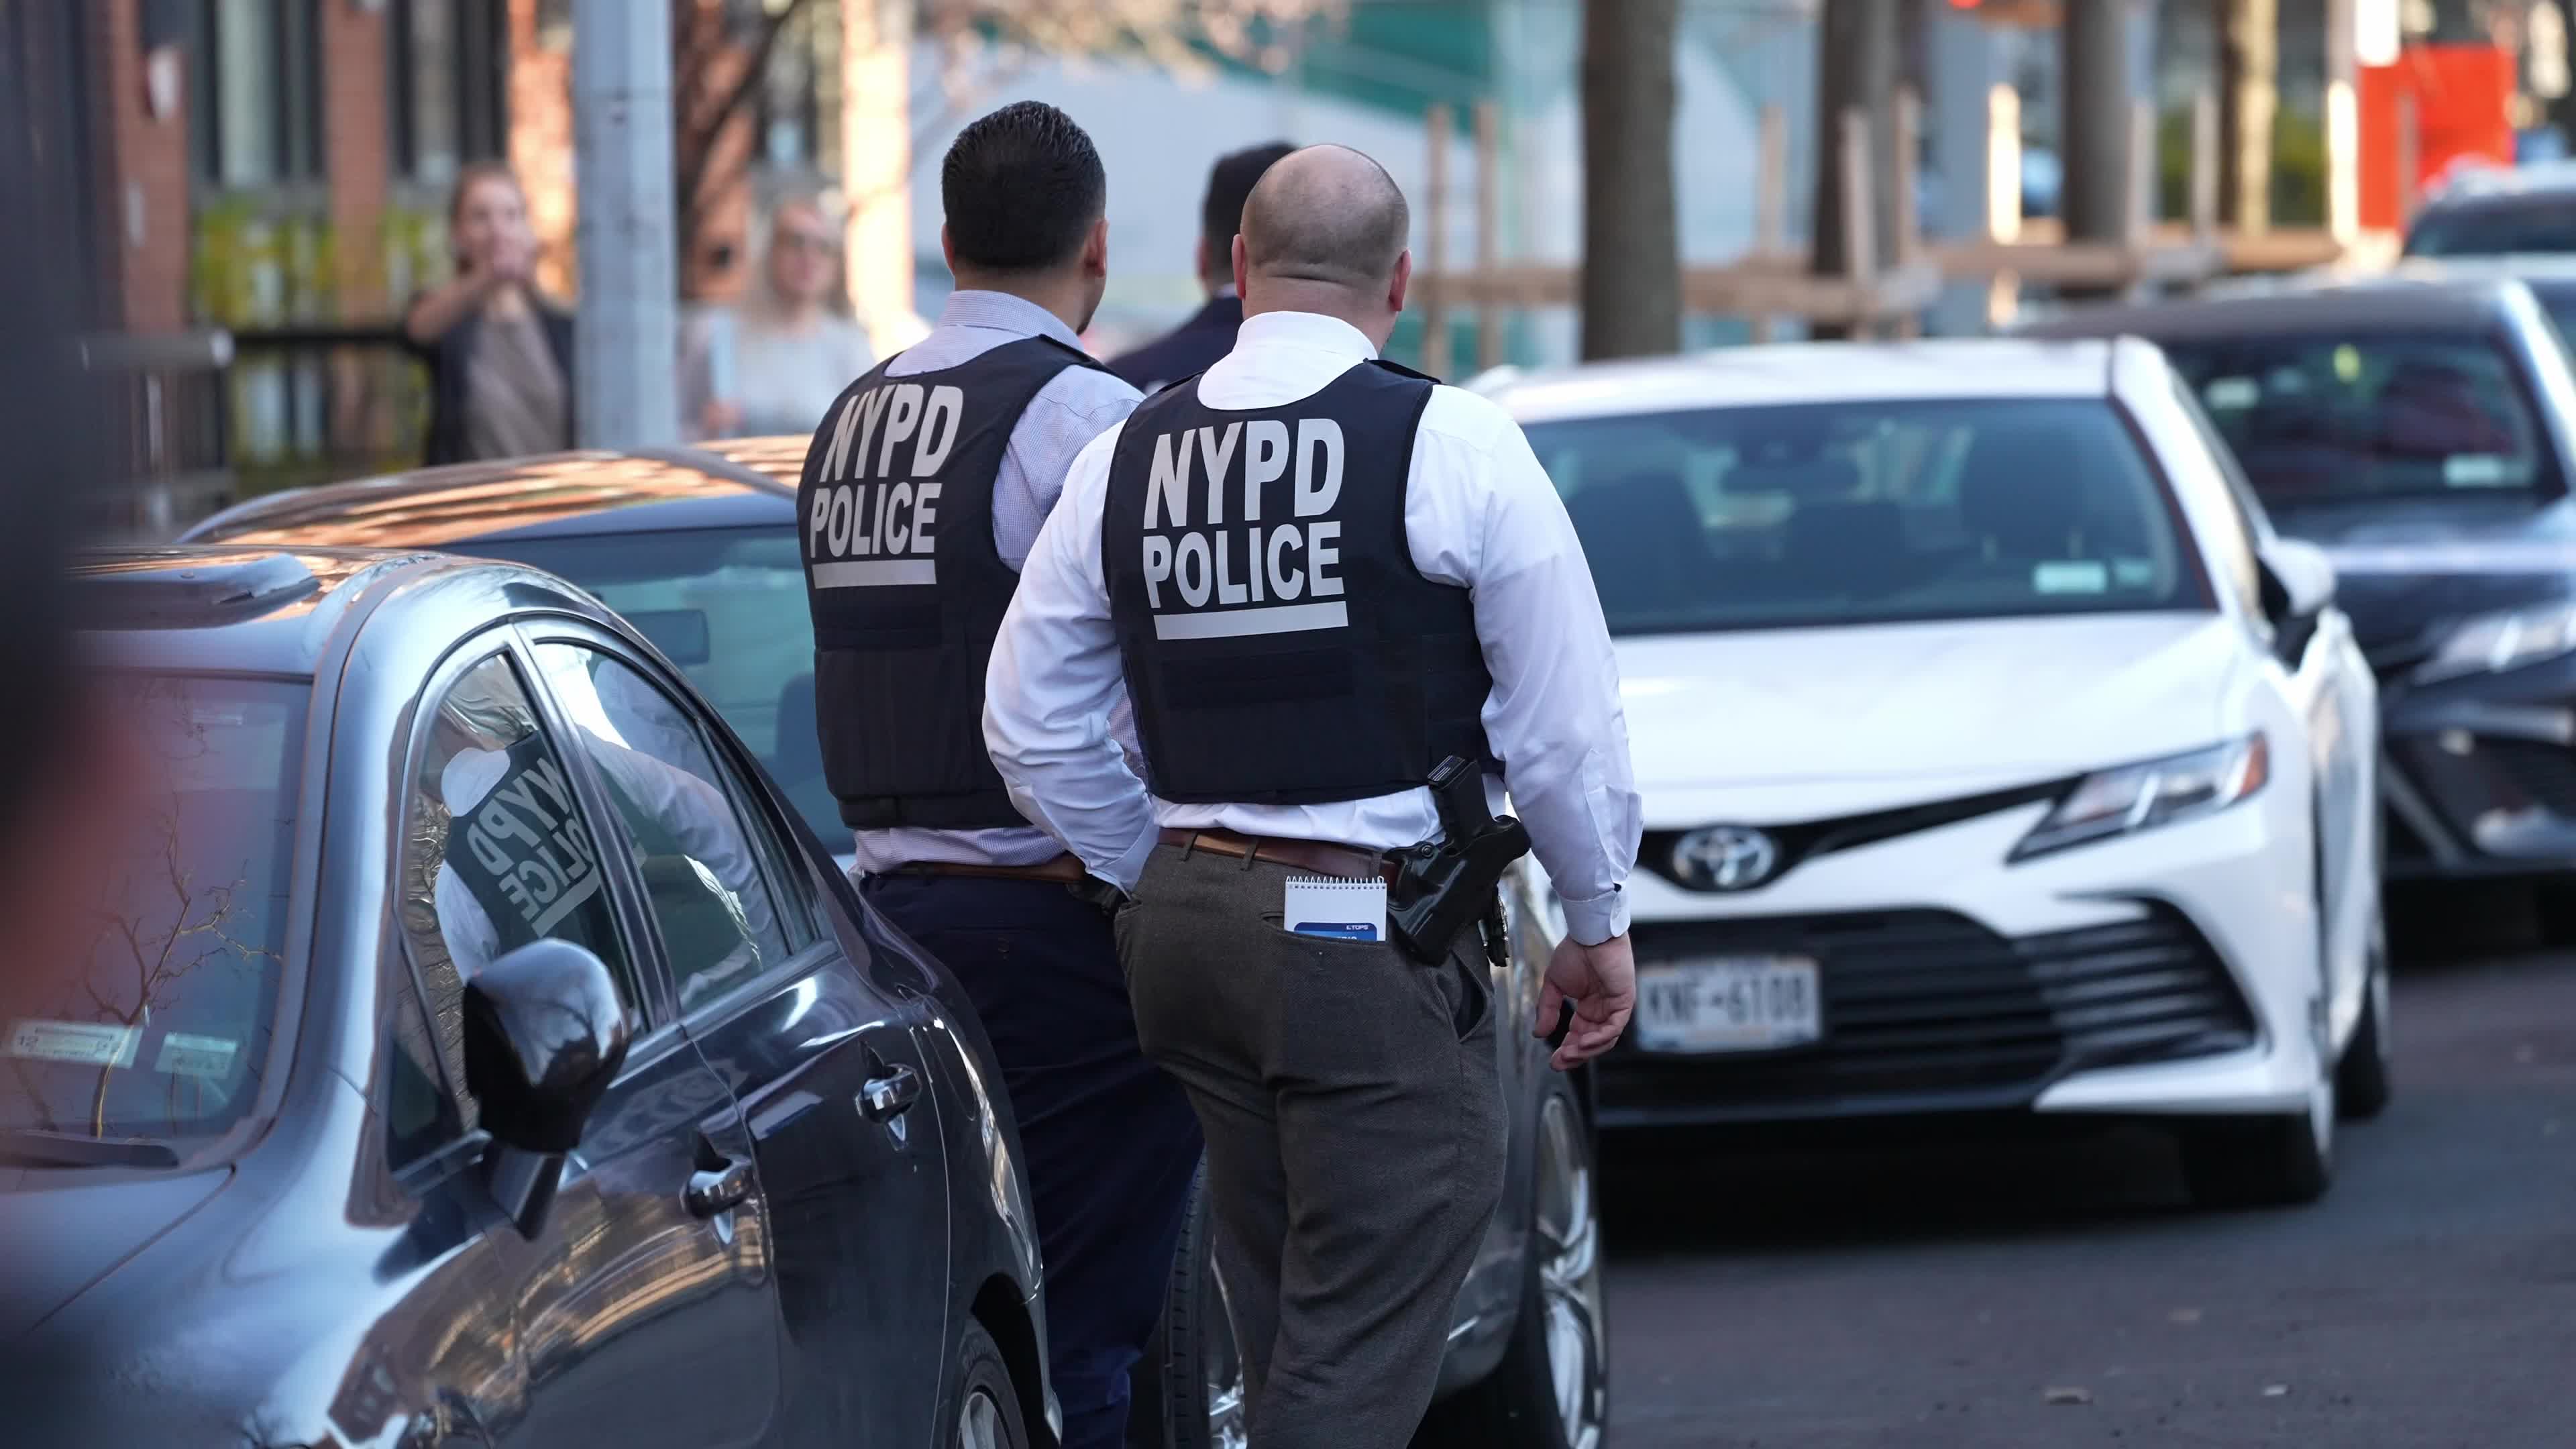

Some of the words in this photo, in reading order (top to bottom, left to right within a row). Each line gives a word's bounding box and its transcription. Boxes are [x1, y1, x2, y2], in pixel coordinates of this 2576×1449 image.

[820, 383, 964, 483] NYPD
[1143, 418, 1345, 531] NYPD
[810, 481, 943, 558] POLICE
[1142, 521, 1345, 609] POLICE
